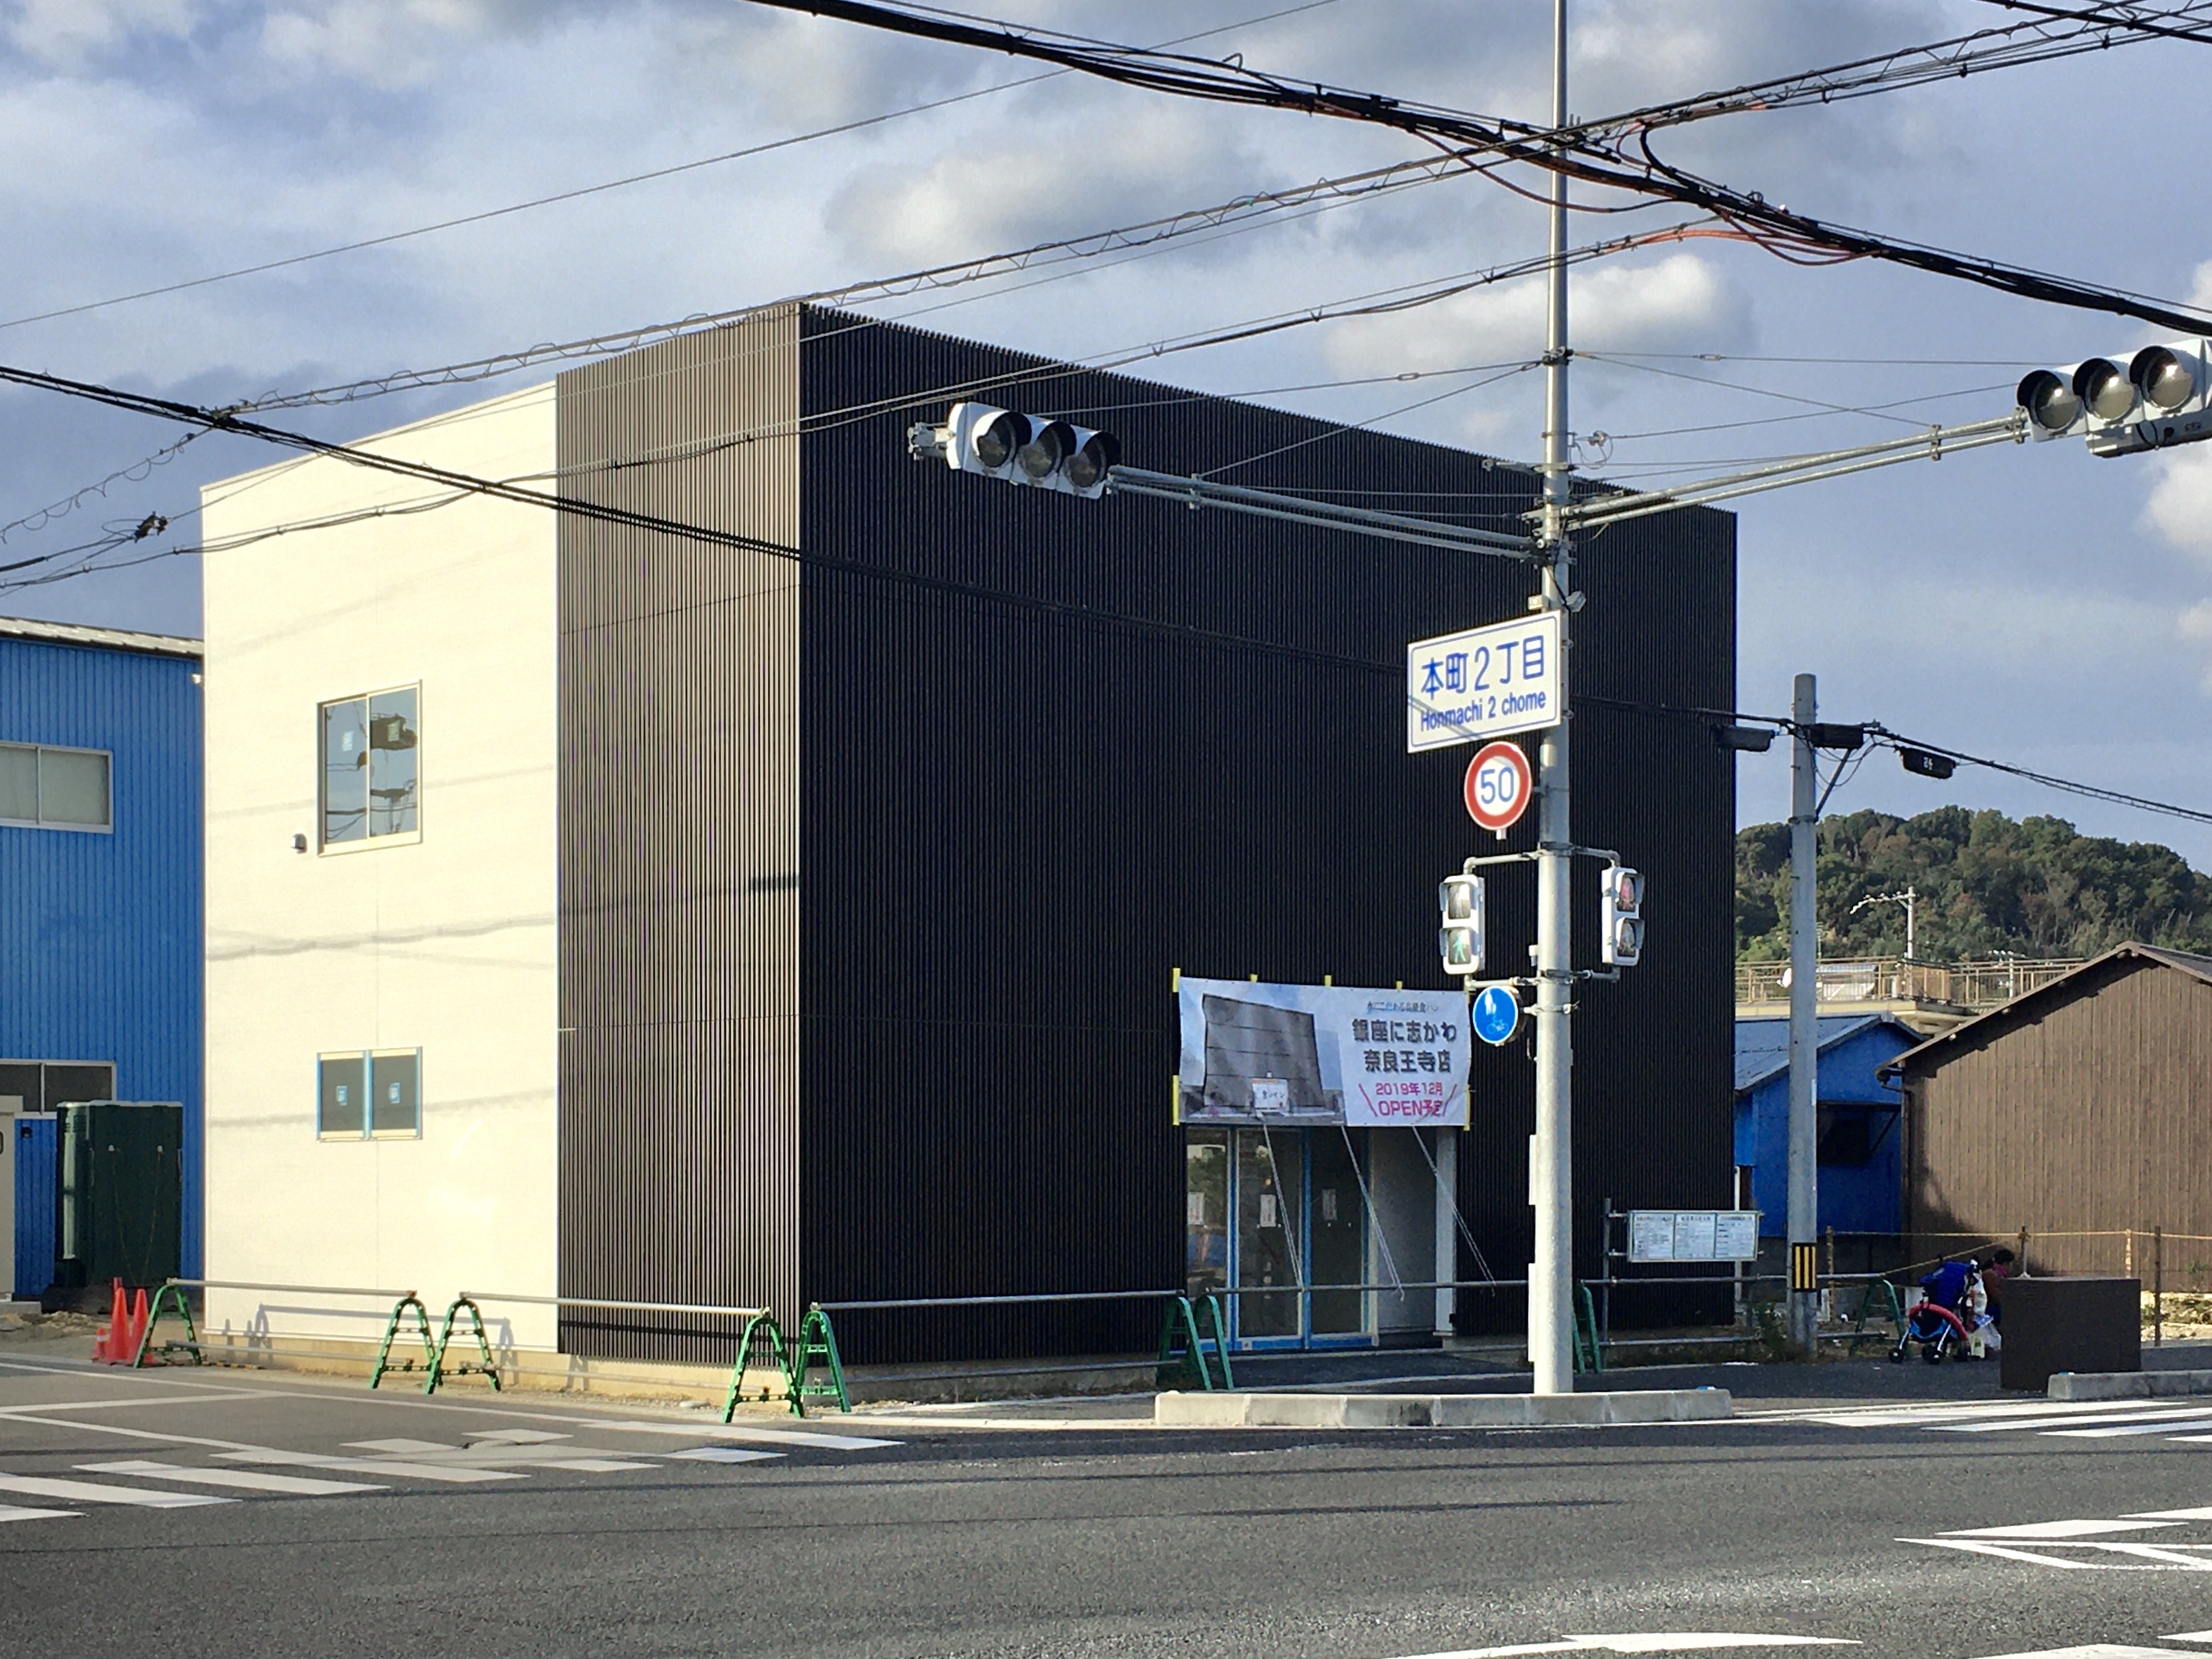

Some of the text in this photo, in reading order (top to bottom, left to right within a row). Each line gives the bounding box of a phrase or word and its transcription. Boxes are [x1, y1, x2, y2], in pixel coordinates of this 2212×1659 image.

[1421, 691, 1546, 731] Honmachi 2 chome
[1480, 766, 1514, 804] 50
[1352, 1018, 1457, 1043] 銀座に志かわ
[1363, 1049, 1452, 1073] 奈良王寺店
[1375, 1082, 1443, 1096] 2019年12月
[1378, 1099, 1443, 1117] OPEN予定
